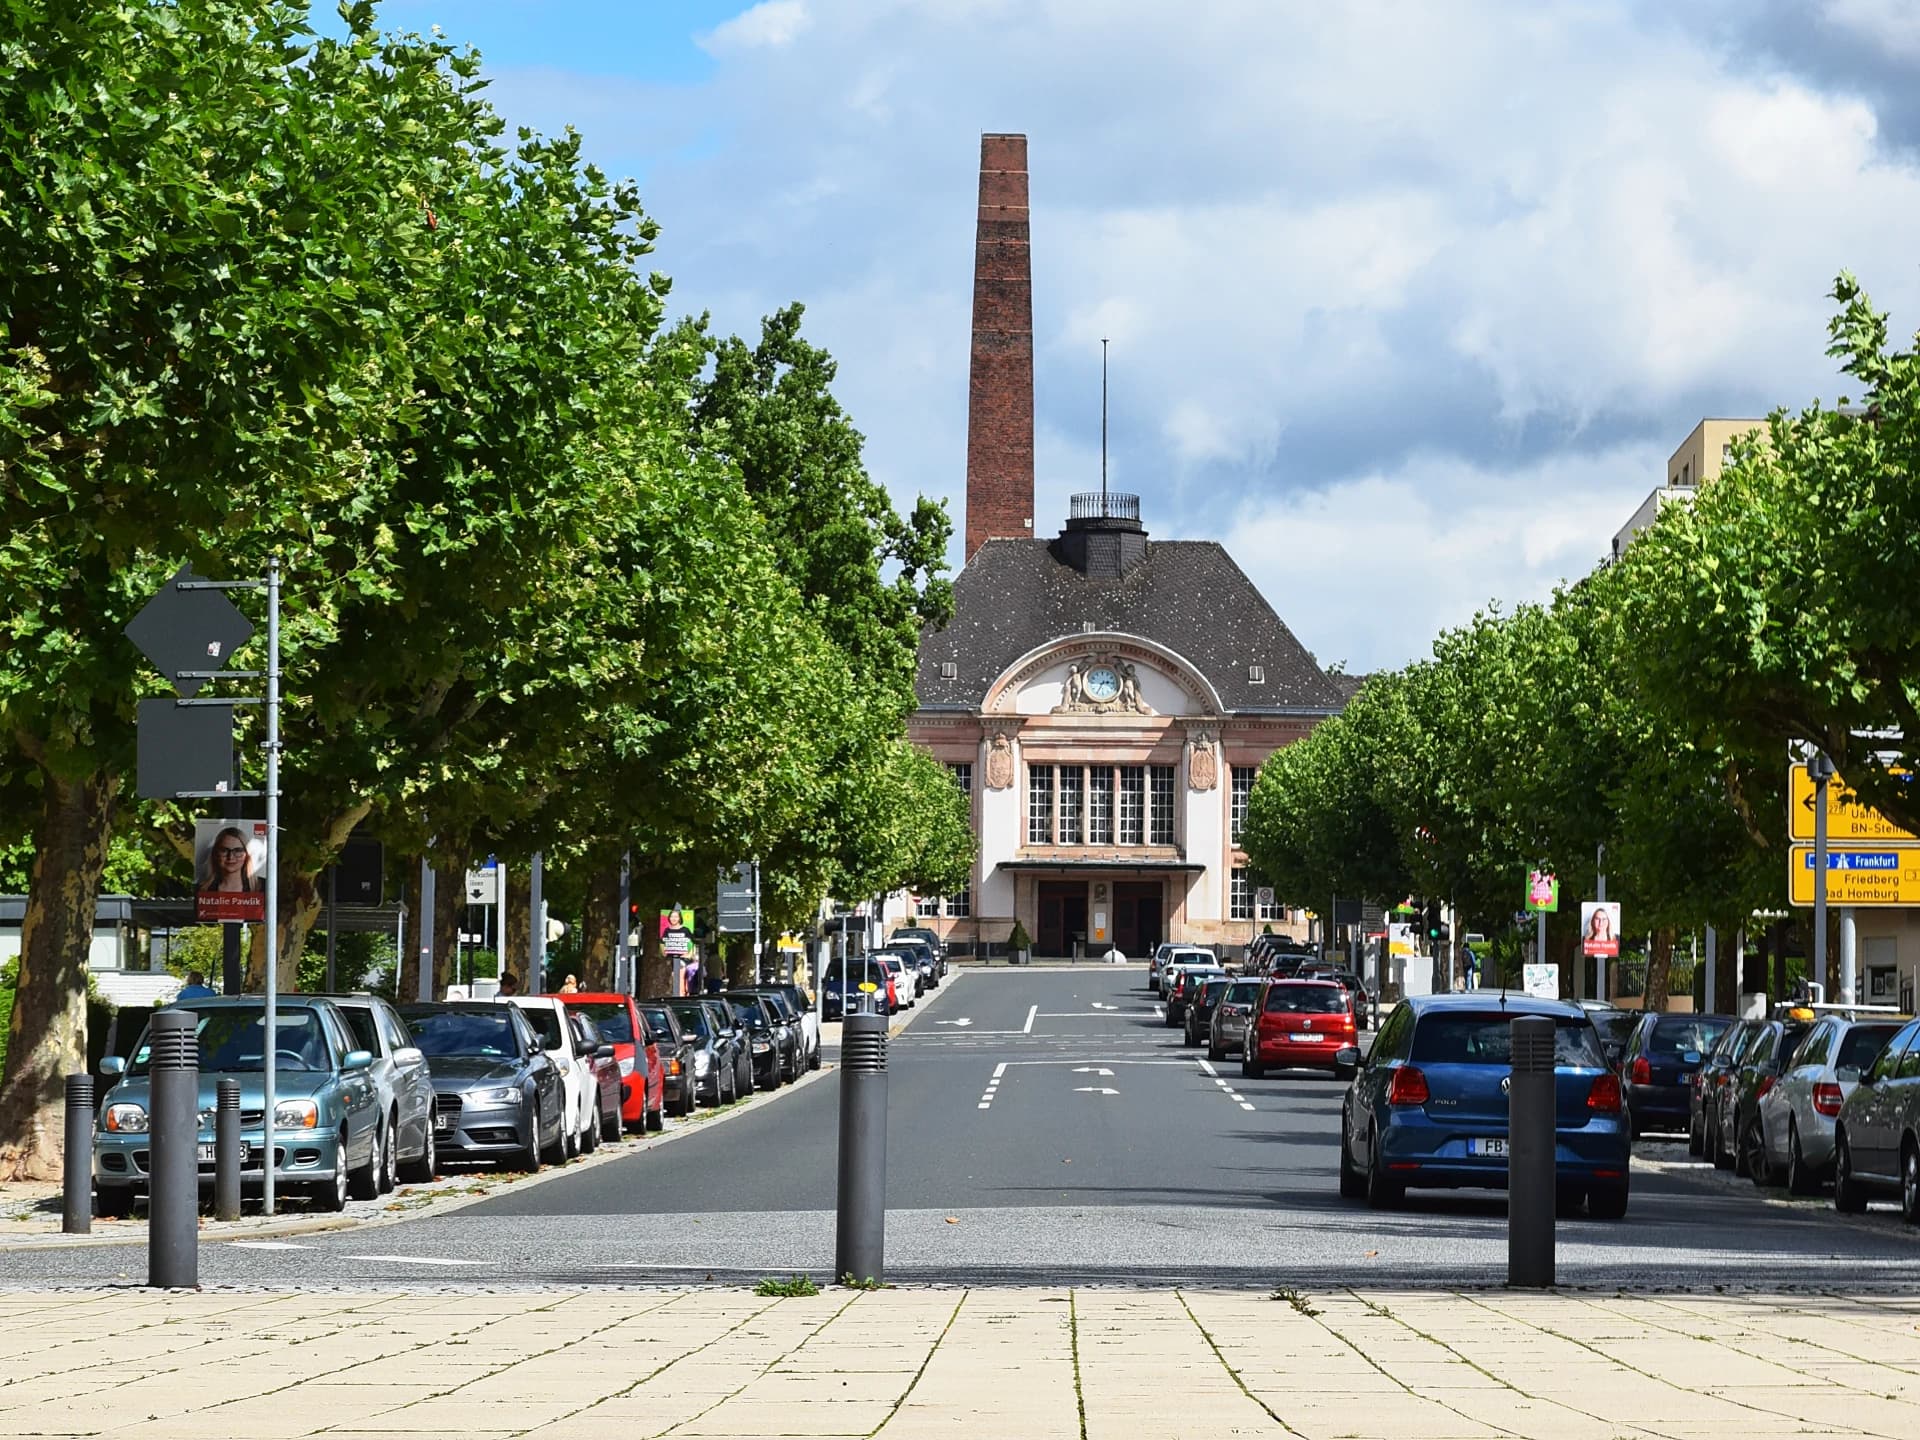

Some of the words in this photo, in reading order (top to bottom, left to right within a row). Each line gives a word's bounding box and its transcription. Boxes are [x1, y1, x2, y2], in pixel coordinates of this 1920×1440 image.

[1855, 856, 1896, 867] Frankfurt
[1844, 874, 1899, 886] Friedberg
[1847, 887, 1899, 902] Homburg
[199, 897, 230, 905] Natalie
[231, 898, 260, 906] Pawlik
[1485, 1140, 1503, 1153] FB
